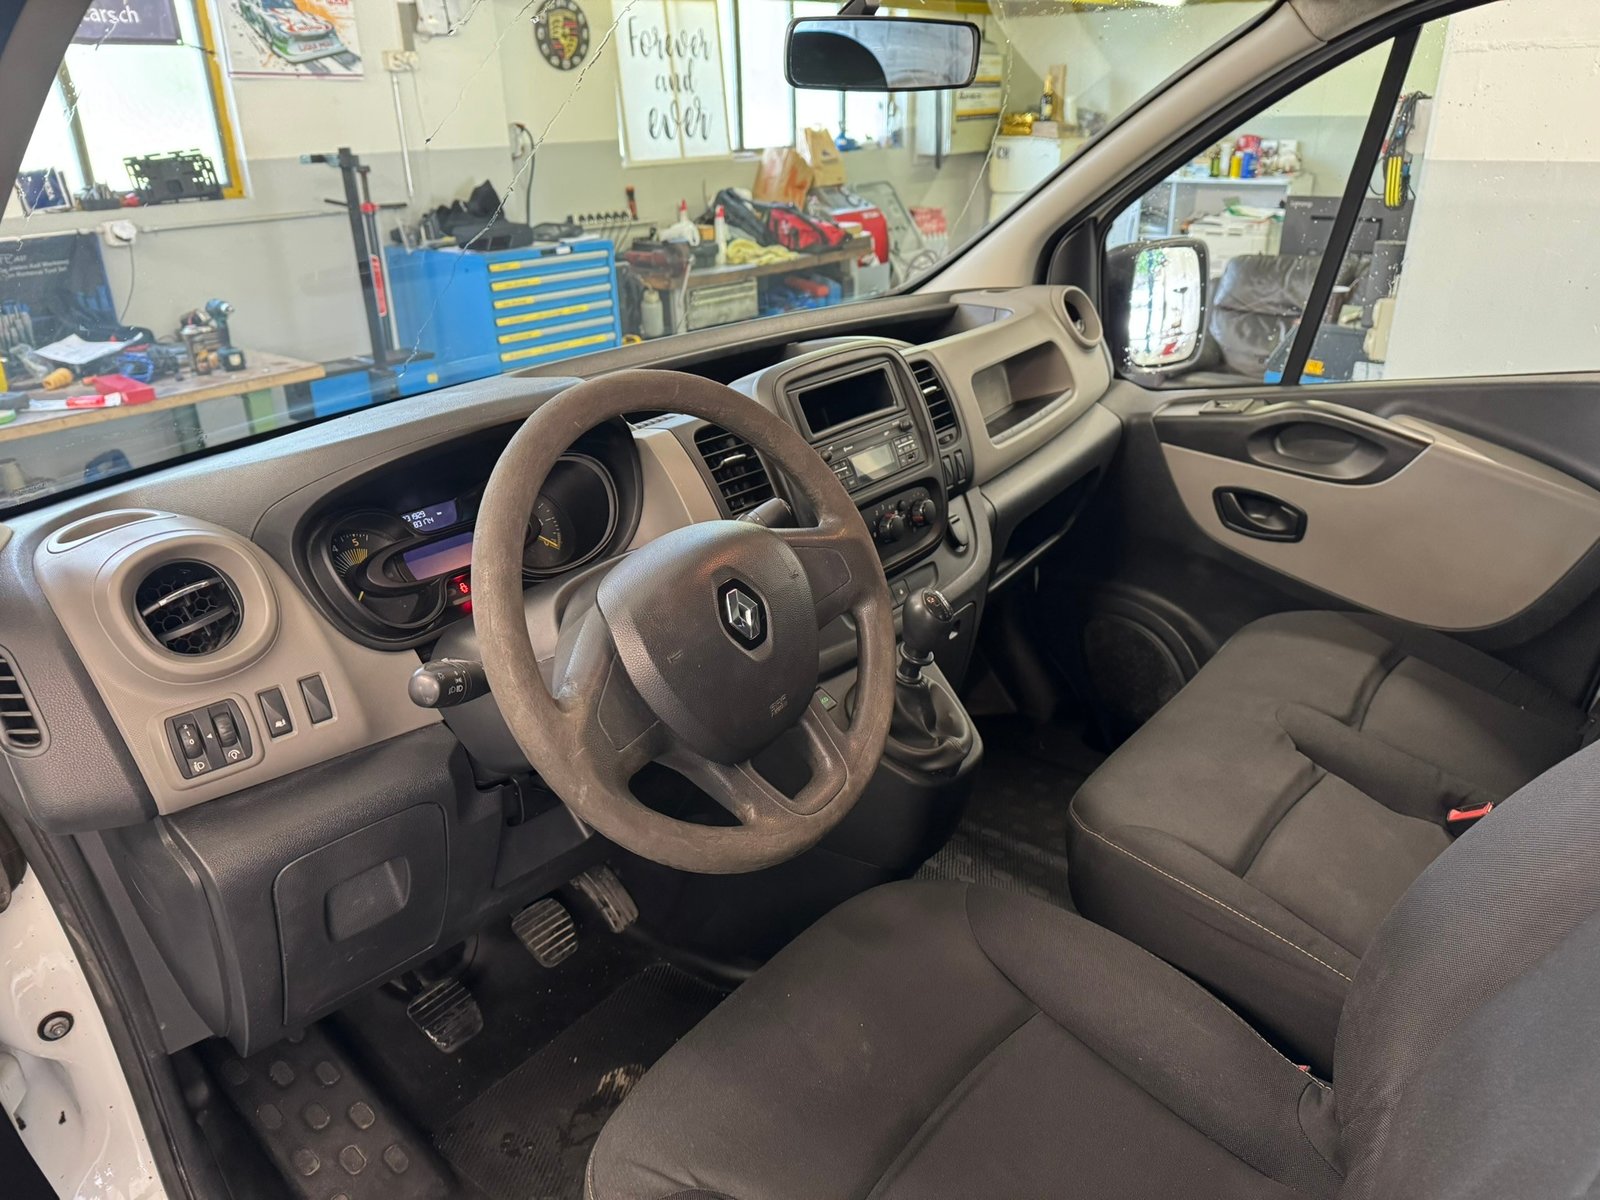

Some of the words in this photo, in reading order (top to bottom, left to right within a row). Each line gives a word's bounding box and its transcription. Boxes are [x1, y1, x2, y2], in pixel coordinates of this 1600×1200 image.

[628, 15, 711, 61] Forever
[655, 58, 694, 94] and
[648, 96, 711, 141] ever
